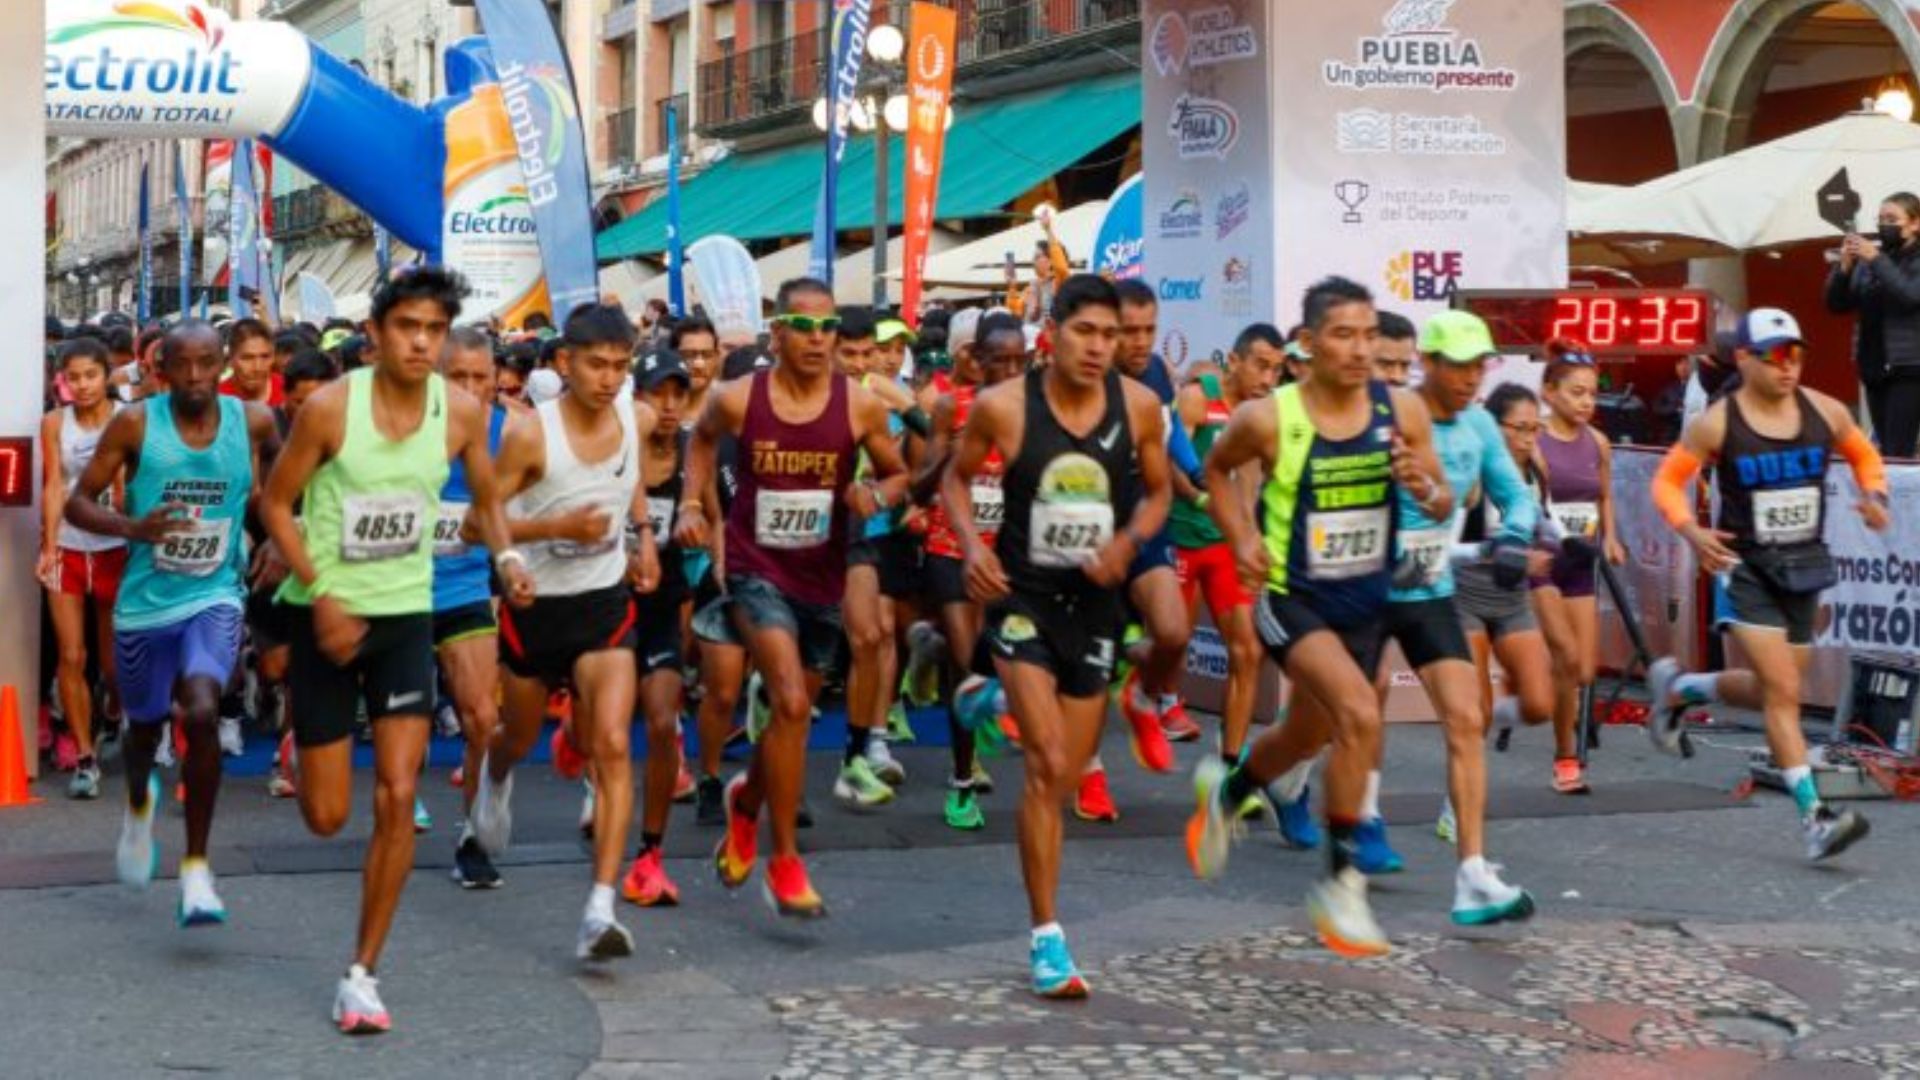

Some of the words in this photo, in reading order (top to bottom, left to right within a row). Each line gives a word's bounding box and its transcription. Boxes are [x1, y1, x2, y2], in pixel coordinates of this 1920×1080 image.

[1362, 41, 1480, 67] PUEBLA
[1326, 64, 1352, 83] Un
[1355, 65, 1434, 87] gobierno
[1436, 70, 1515, 90] presente
[153, 106, 234, 124] TOTAL!
[1413, 251, 1463, 277] PUE
[1413, 276, 1459, 301] BLA
[752, 450, 839, 476] ZATOPEK
[353, 512, 415, 539] 4853
[768, 507, 818, 532] 3710
[1044, 522, 1101, 548] 4672
